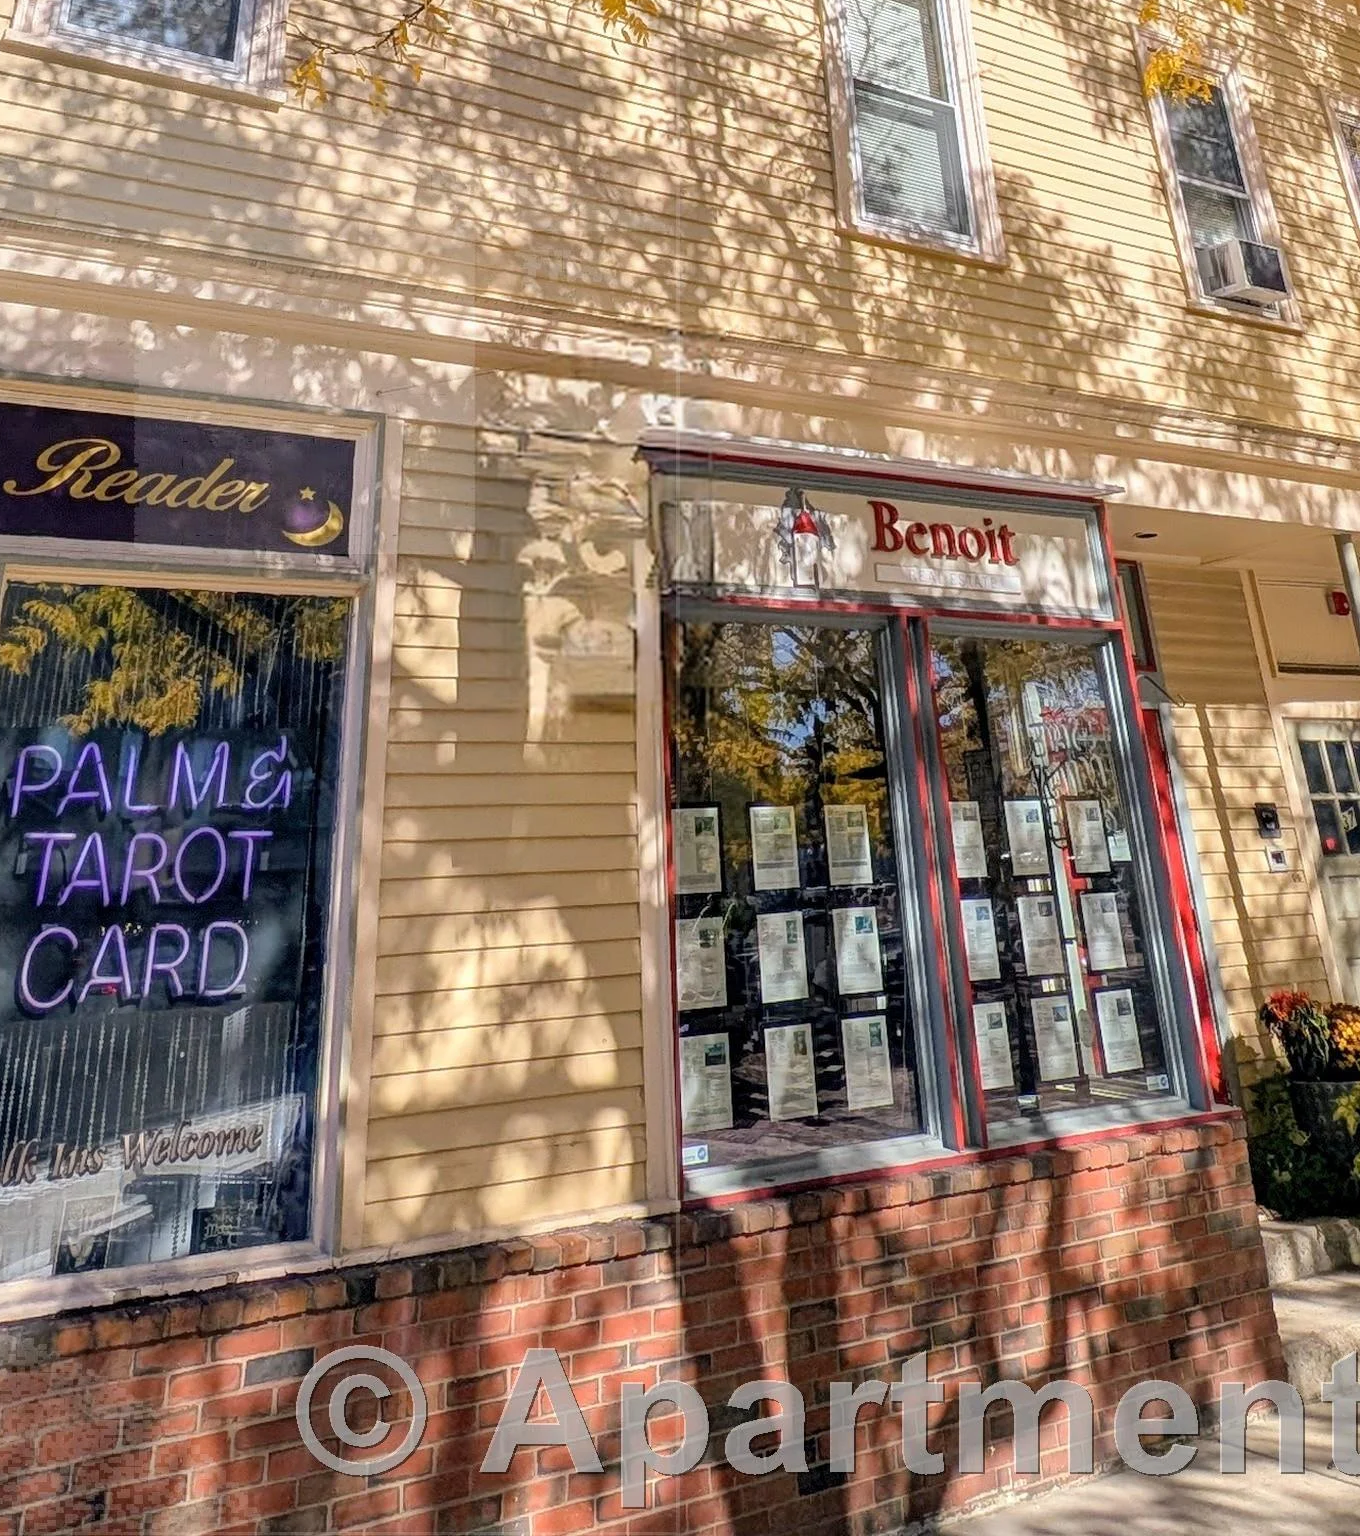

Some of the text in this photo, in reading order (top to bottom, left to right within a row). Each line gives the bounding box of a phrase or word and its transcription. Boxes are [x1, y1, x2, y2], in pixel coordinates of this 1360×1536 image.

[4, 437, 270, 514] Reader
[867, 500, 1021, 567] Benoit
[26, 826, 274, 908] TAROT
[18, 919, 251, 1009] CARD
[46, 1141, 107, 1182] Ins
[120, 1117, 266, 1172] Welcome
